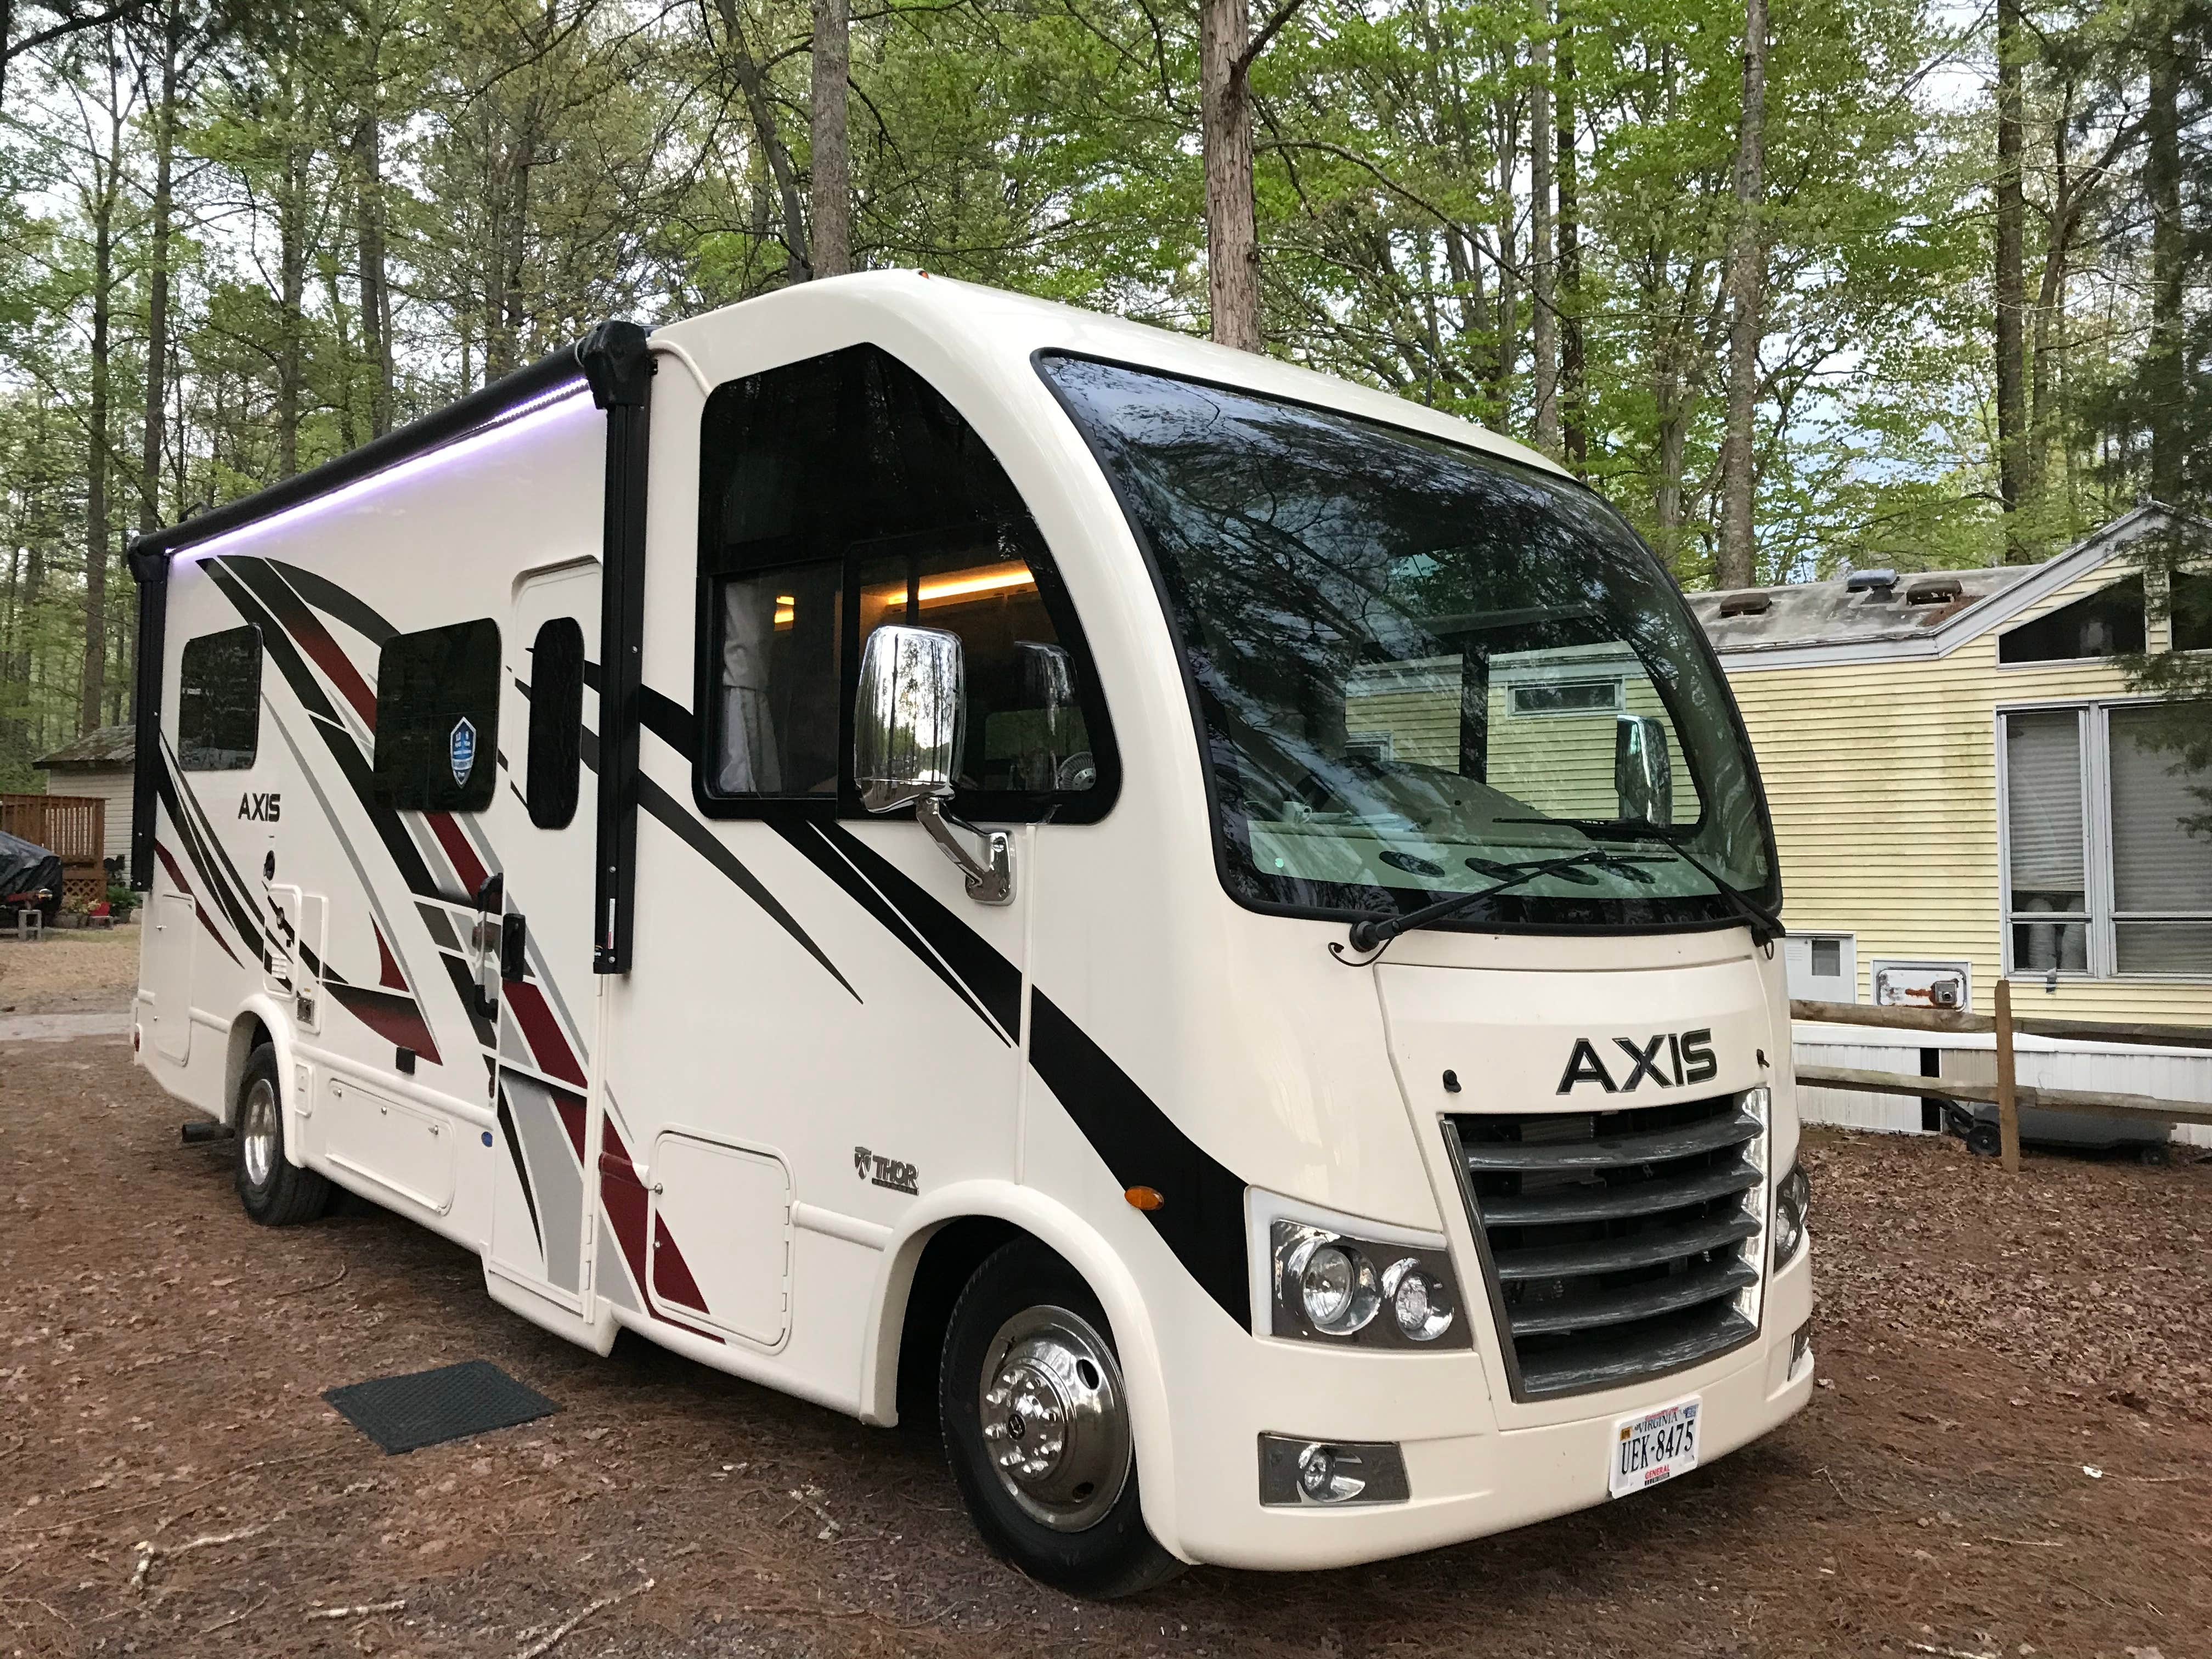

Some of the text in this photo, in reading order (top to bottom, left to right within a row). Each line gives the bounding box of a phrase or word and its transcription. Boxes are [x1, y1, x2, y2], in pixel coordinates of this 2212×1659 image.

[238, 792, 281, 822] AXIS
[1556, 1028, 1718, 1095] AXIS
[872, 1154, 919, 1189] THOR
[1638, 1411, 1678, 1434] VIRGINIA
[1645, 1464, 1671, 1480] GENERAL
